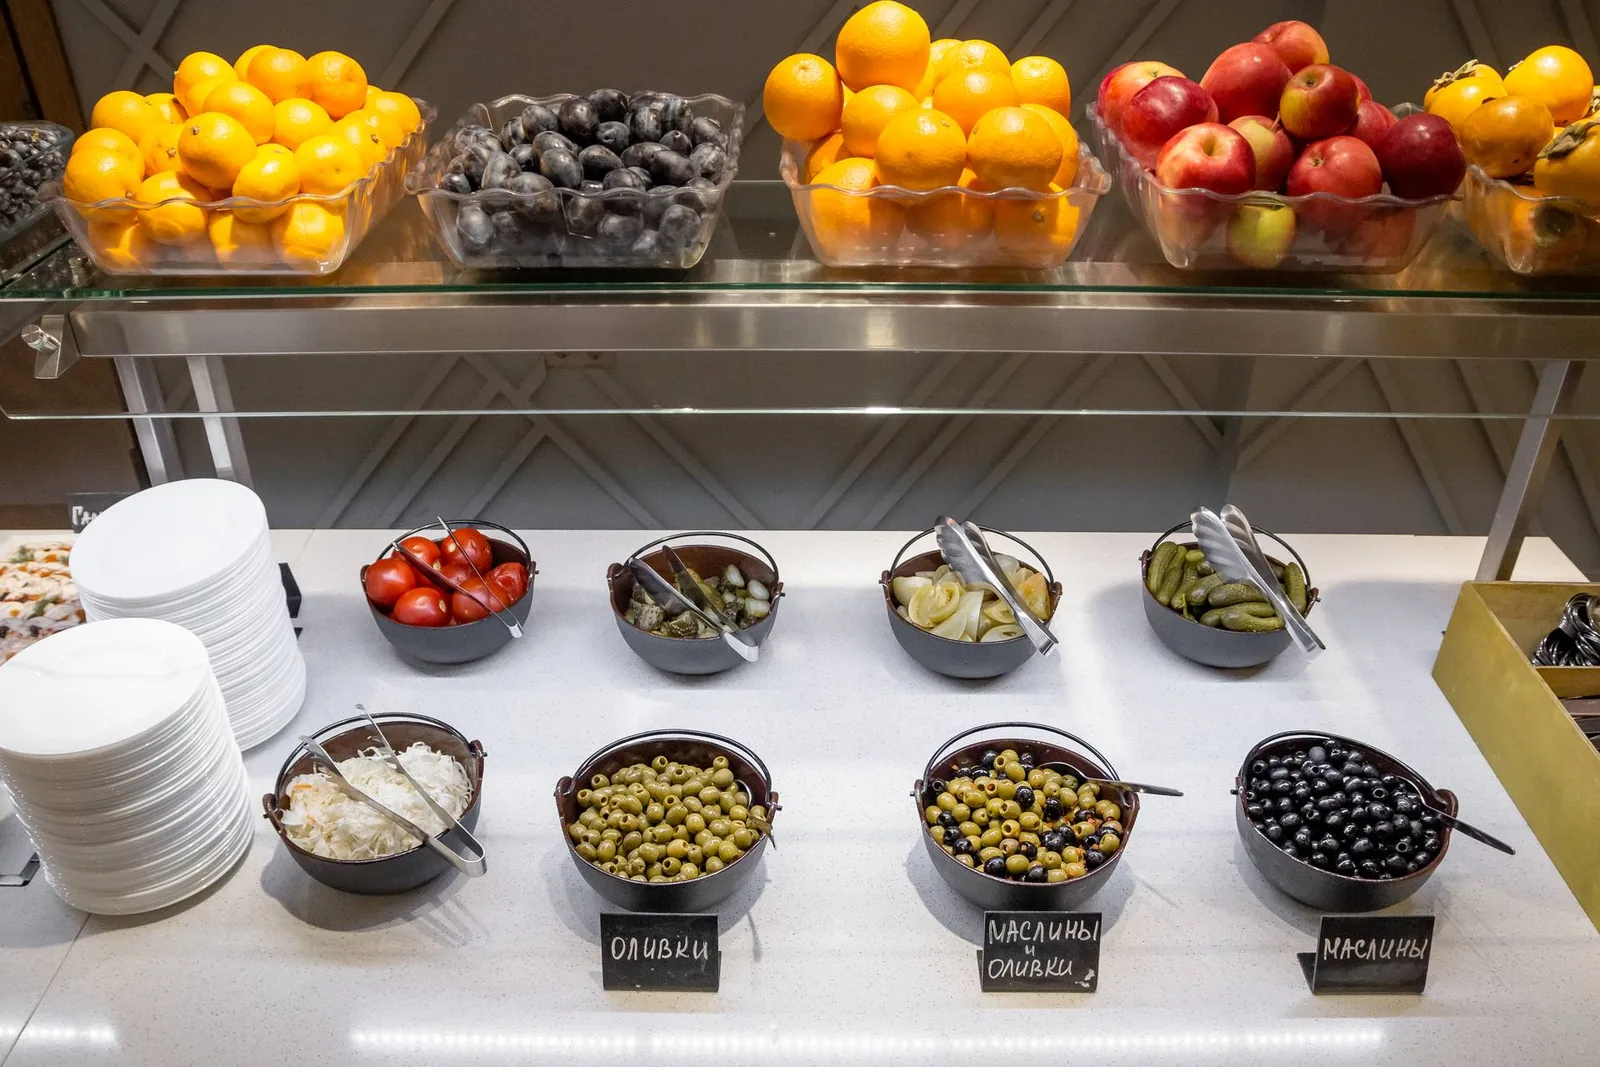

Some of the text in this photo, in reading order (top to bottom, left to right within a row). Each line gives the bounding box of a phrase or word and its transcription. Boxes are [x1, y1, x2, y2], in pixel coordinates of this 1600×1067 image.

[988, 919, 1099, 944] МАСЛИНЫ
[611, 936, 708, 960] ОЛИВКИ
[1323, 937, 1428, 960] МАСЛИНЫ
[988, 956, 1072, 979] ОЛИВКИ
